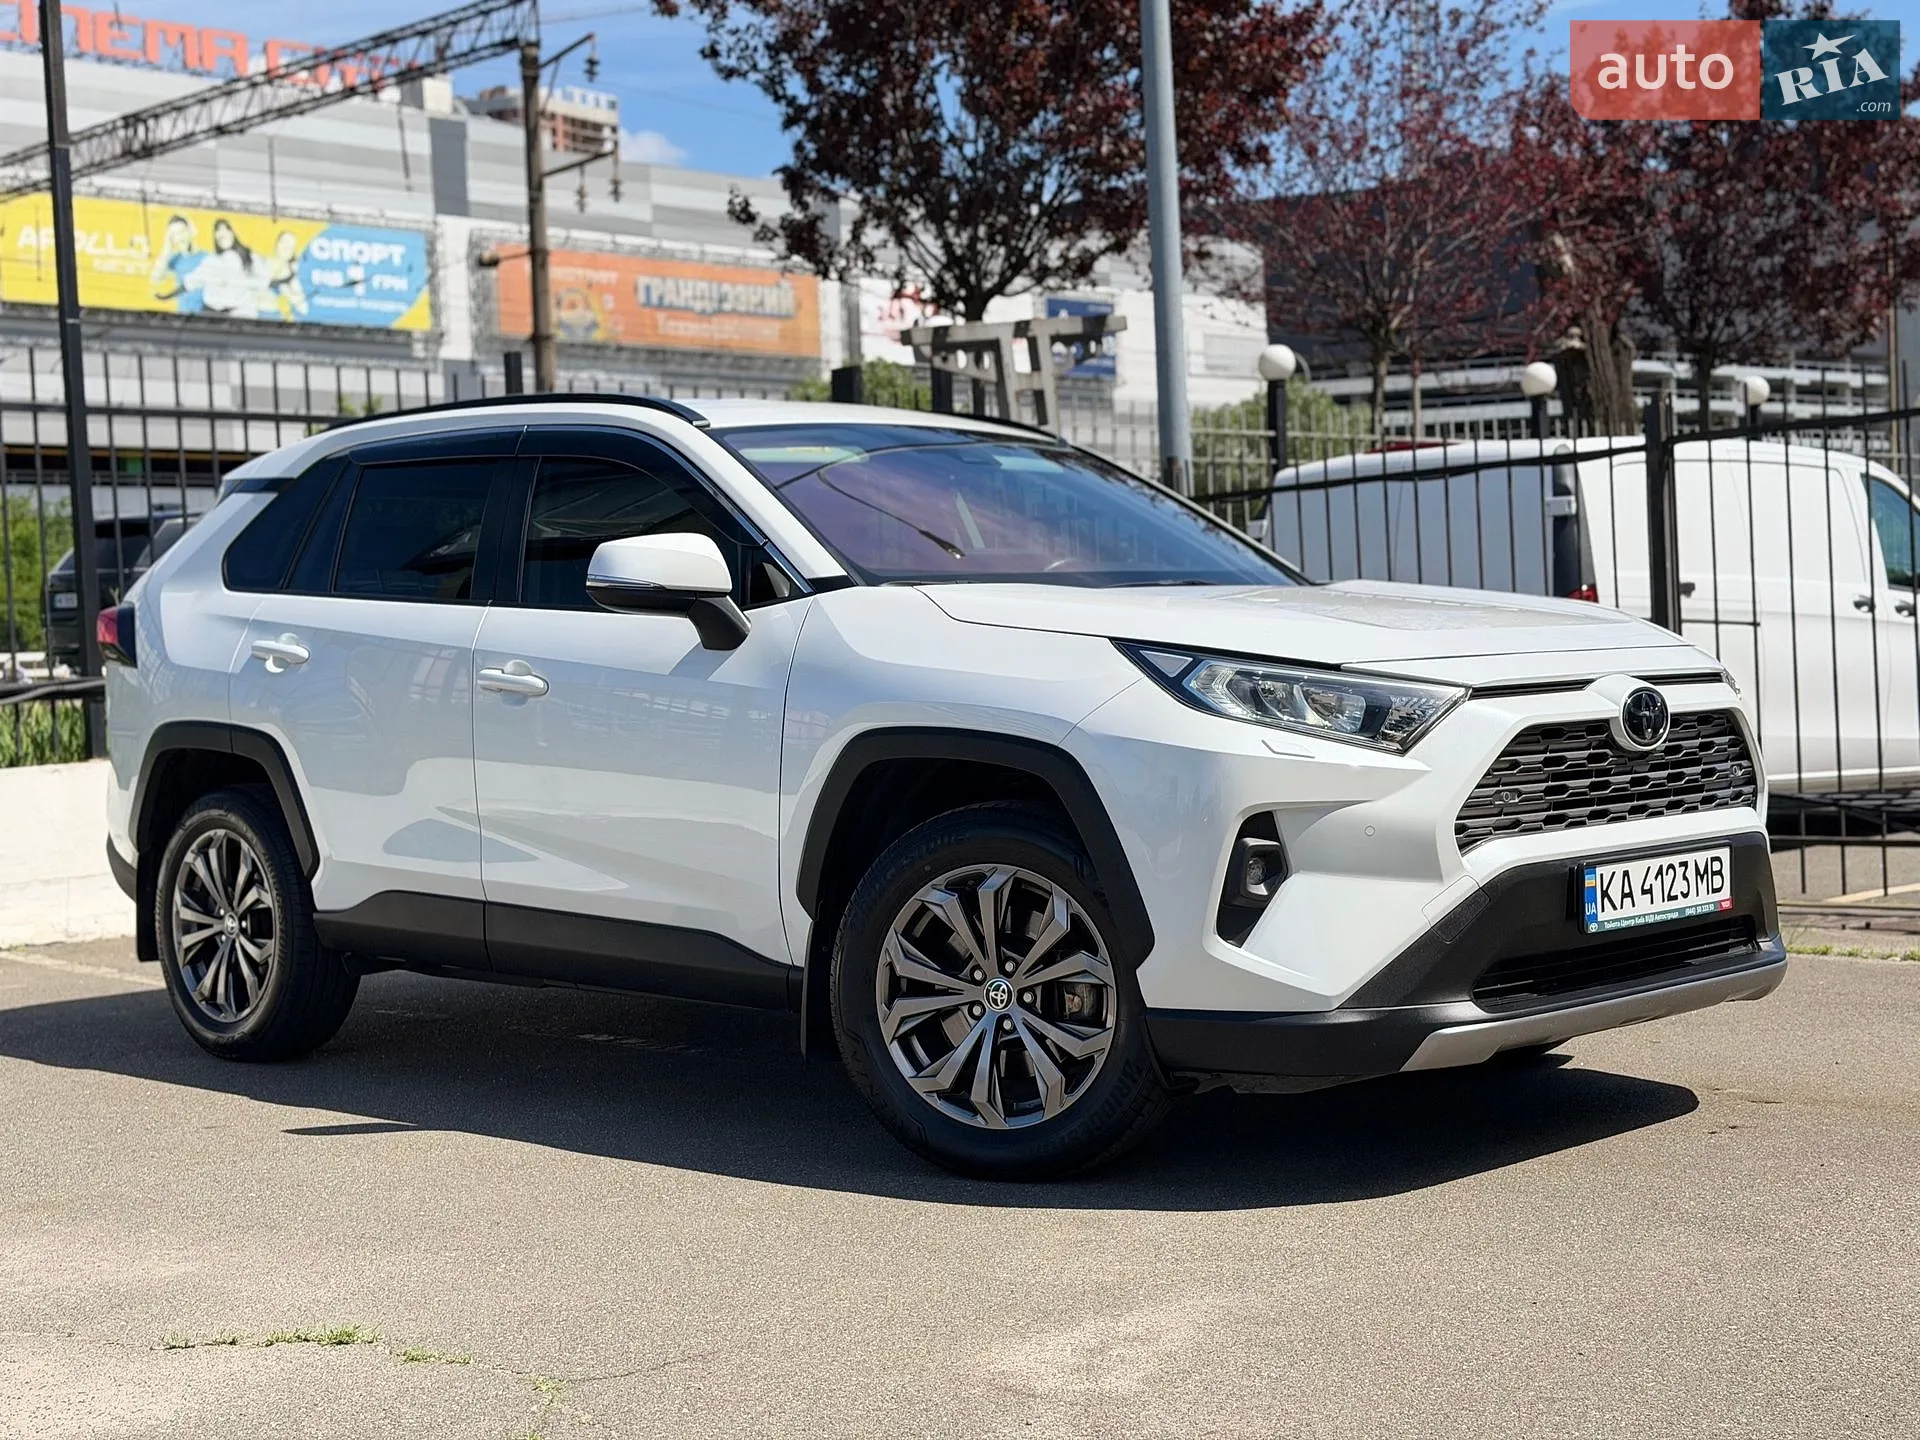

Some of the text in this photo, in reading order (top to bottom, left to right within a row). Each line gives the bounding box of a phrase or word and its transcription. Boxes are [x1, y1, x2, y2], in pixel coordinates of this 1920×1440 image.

[310, 237, 406, 267] СПОРТ
[1599, 856, 1725, 913] KA 4123 MB
[1585, 902, 1597, 916] UA
